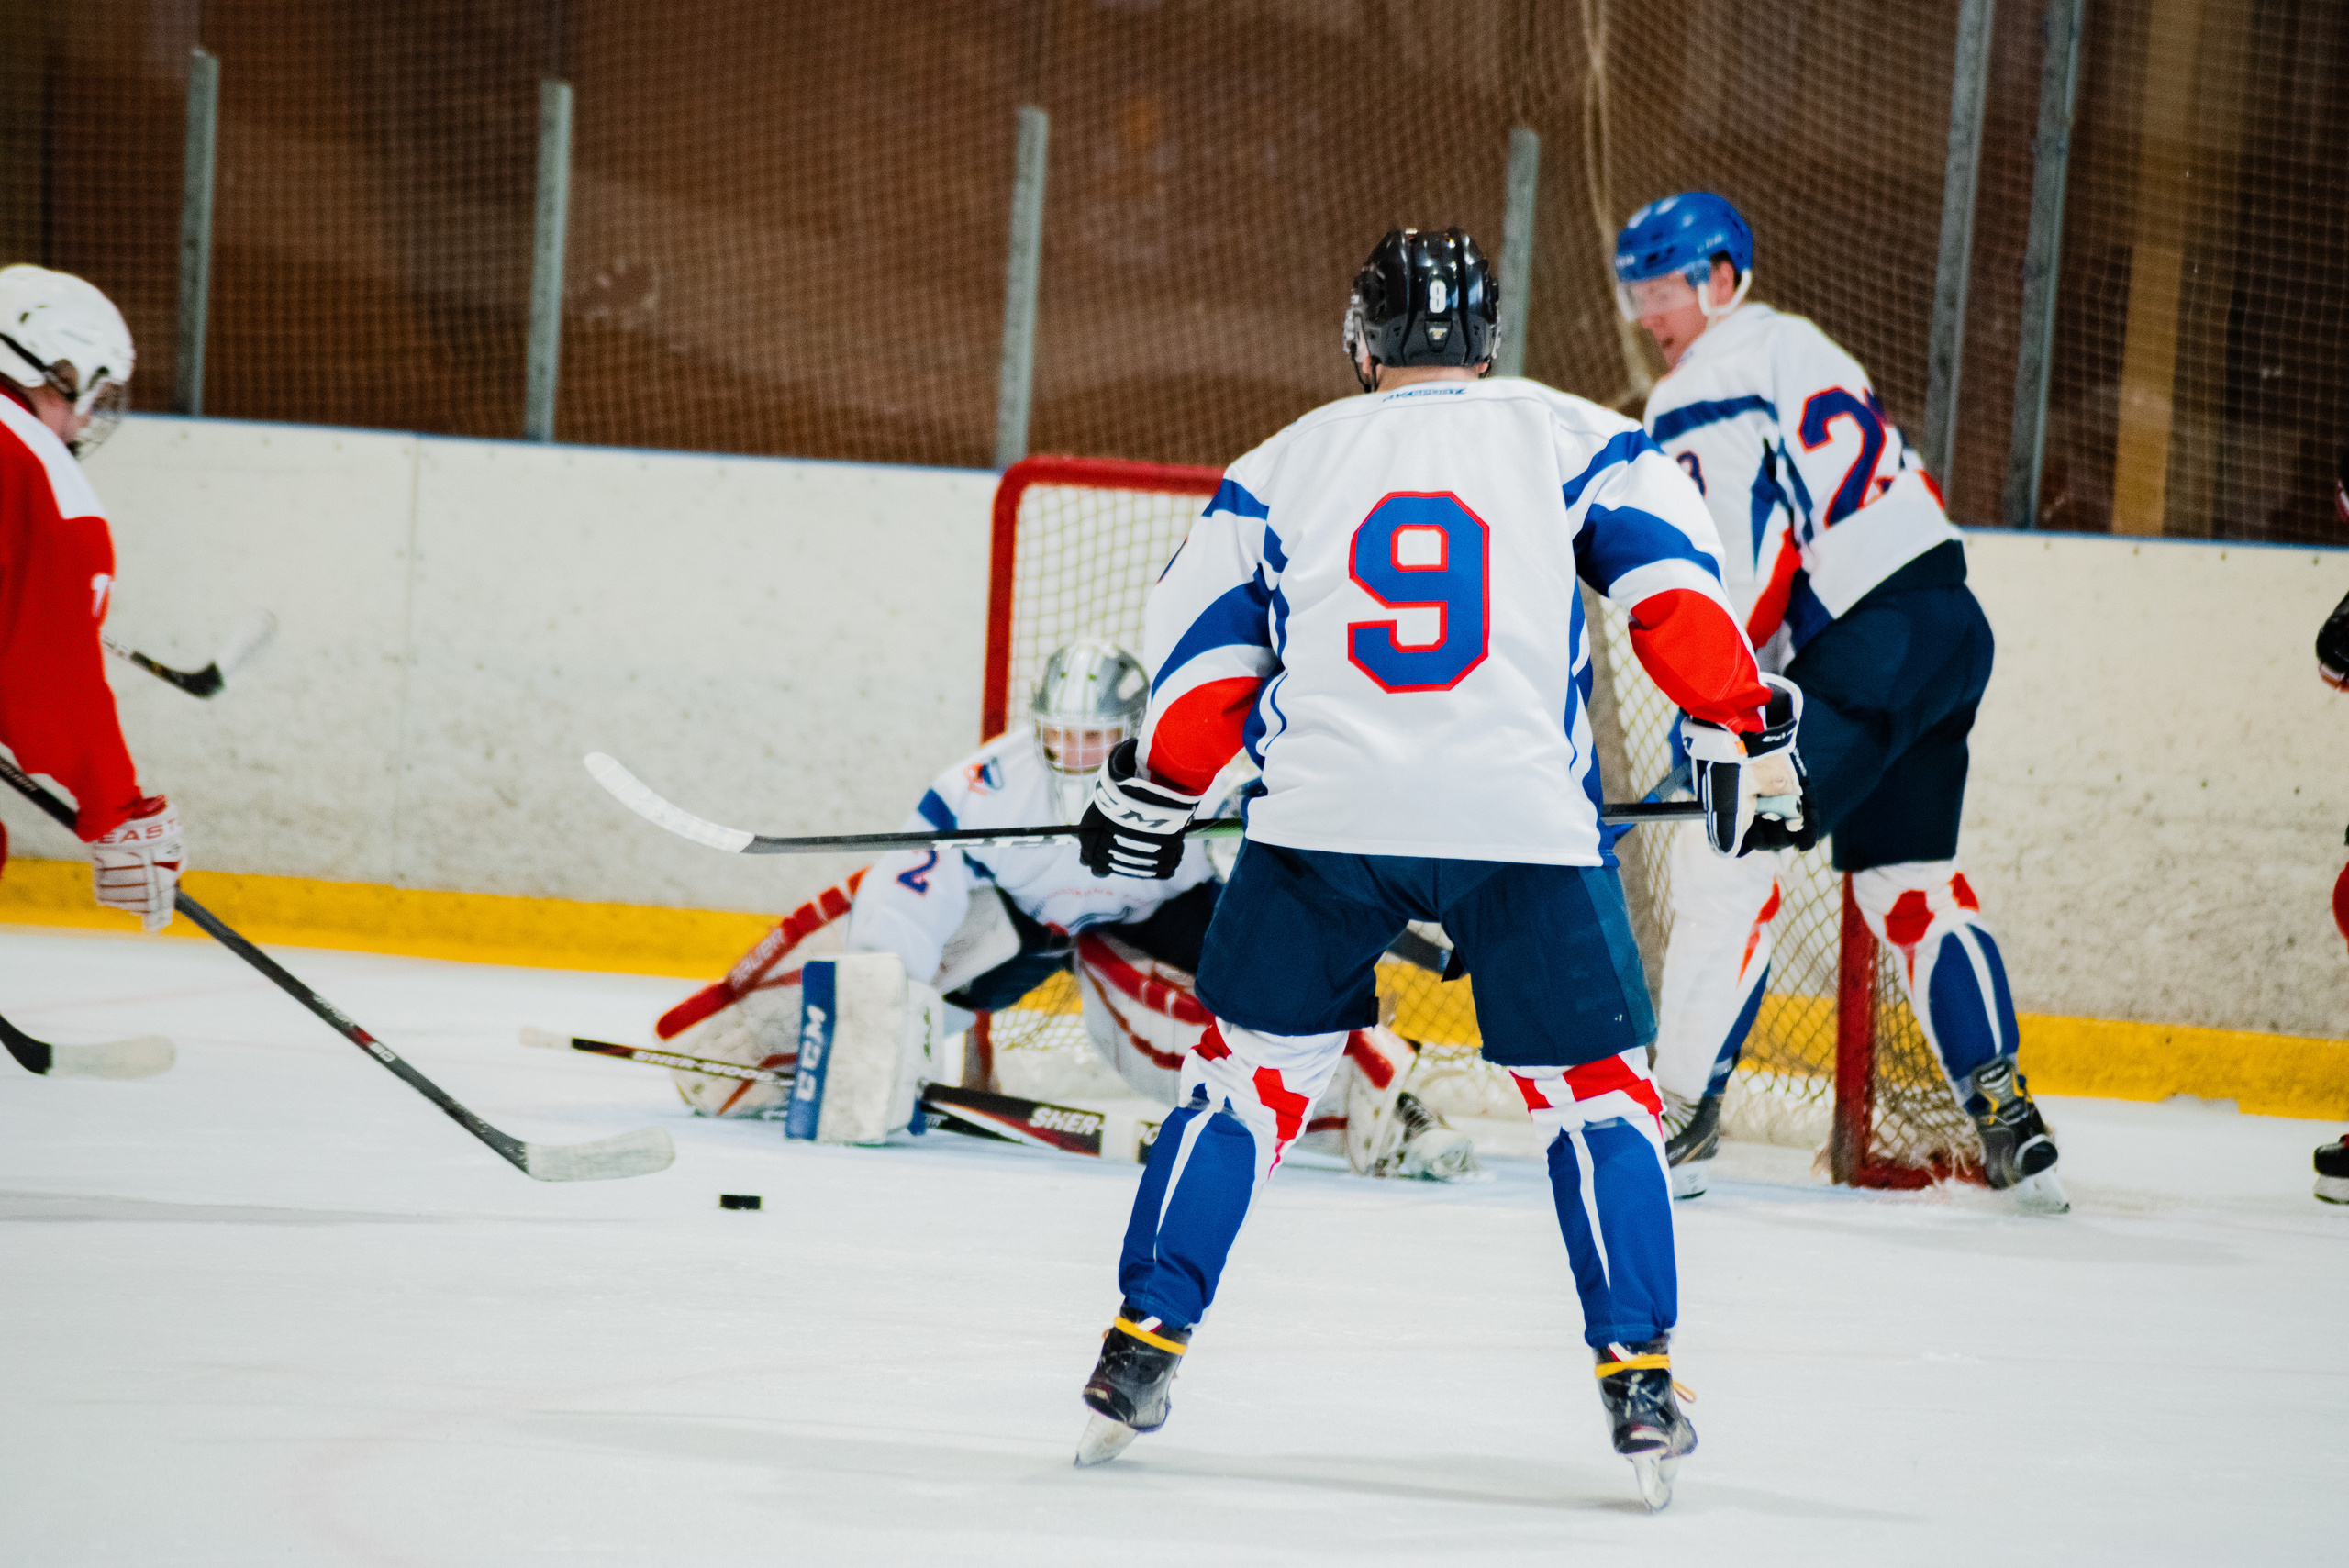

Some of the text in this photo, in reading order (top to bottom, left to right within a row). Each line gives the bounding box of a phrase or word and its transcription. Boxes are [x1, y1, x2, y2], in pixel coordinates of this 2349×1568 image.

[1347, 490, 1490, 695] 9
[632, 1051, 775, 1082] SHER-WOOD
[796, 1004, 828, 1102] CCM
